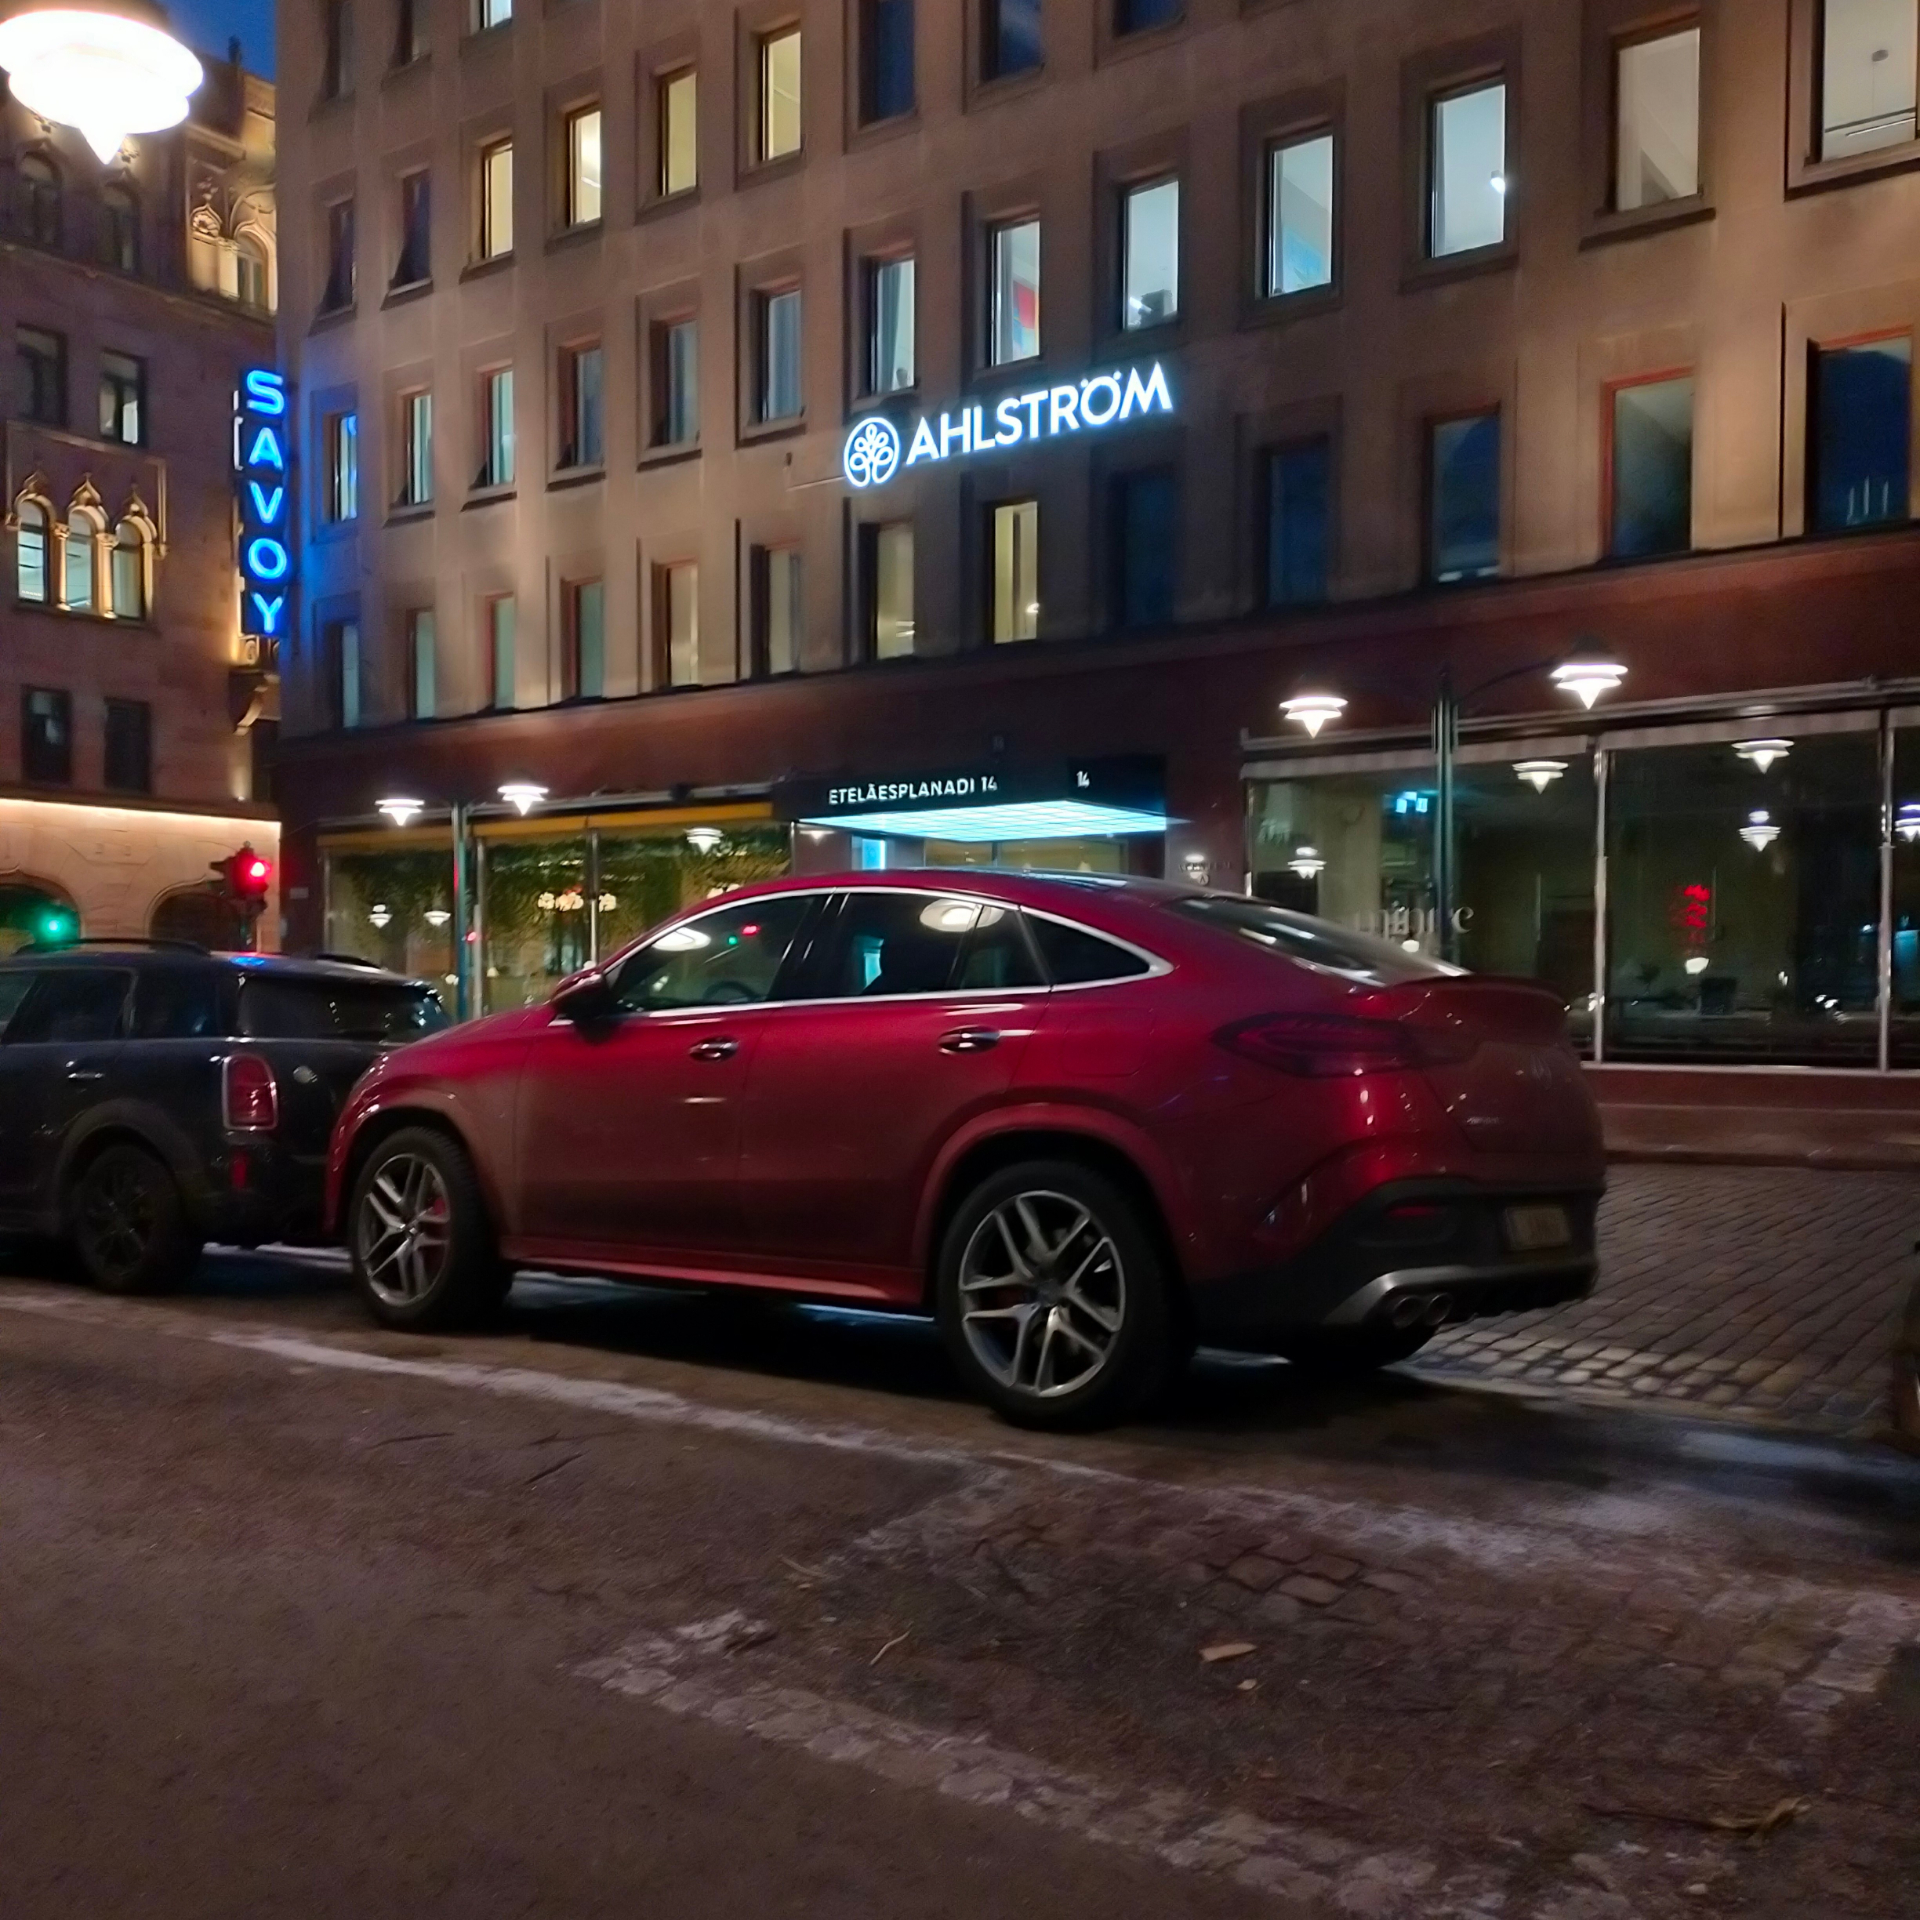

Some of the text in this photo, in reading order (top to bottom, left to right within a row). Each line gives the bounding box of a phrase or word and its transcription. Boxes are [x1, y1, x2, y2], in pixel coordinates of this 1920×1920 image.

[905, 361, 1174, 466] AHLSTRÖM
[246, 369, 287, 634] SAVOY
[828, 776, 998, 805] ETELÄESPLANADI 14
[1076, 770, 1090, 788] 14
